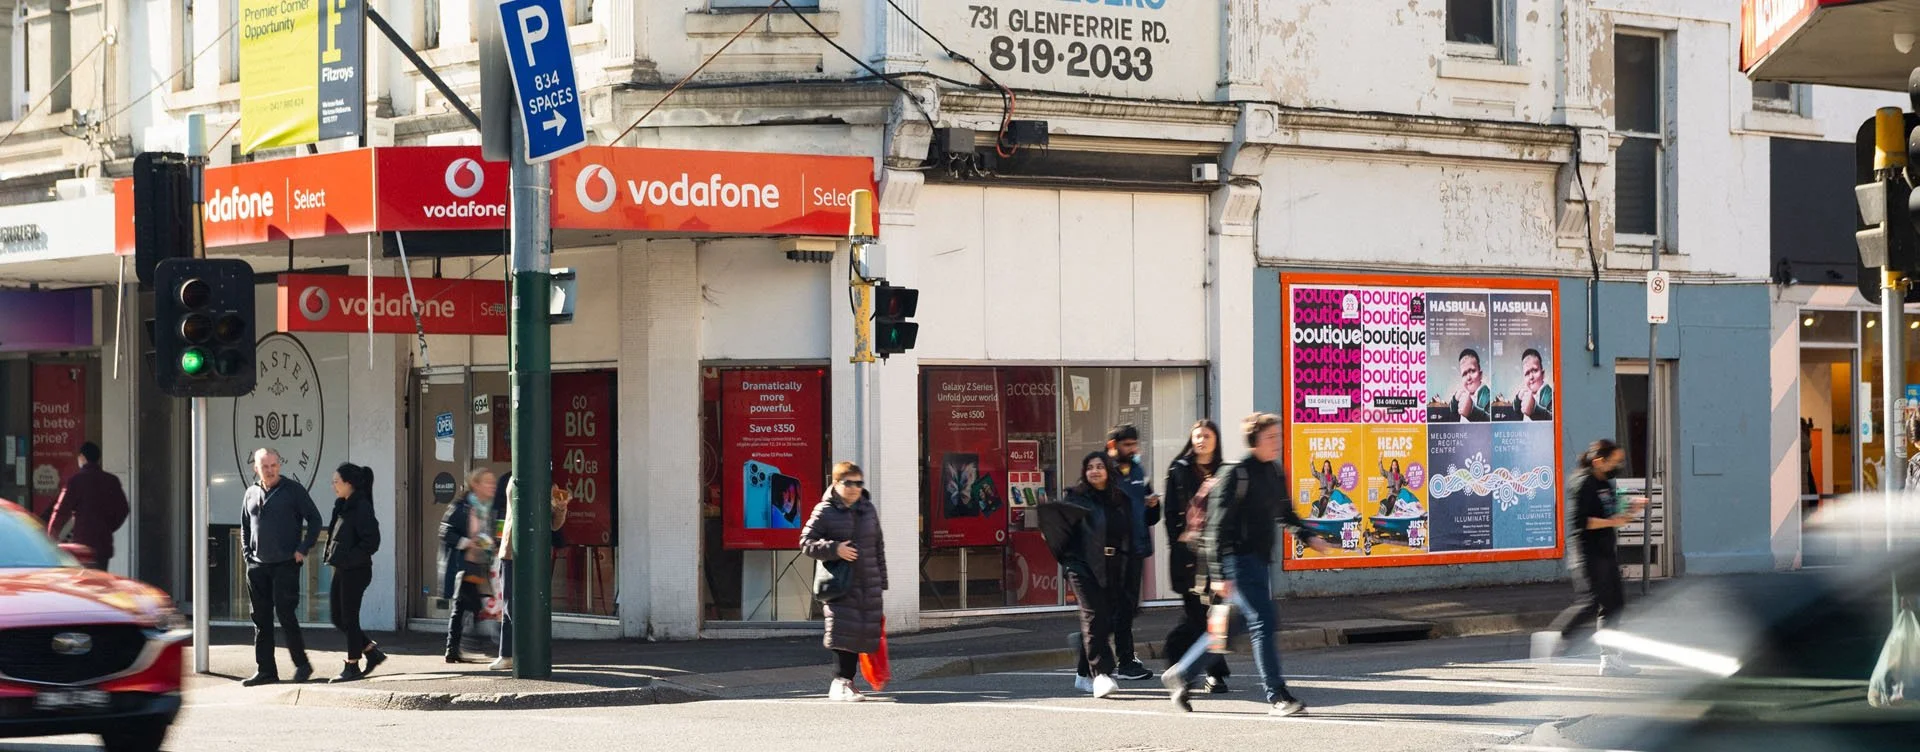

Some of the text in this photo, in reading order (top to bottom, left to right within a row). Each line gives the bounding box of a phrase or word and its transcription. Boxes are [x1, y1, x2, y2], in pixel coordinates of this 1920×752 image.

[245, 5, 278, 21] Premier
[245, 18, 295, 40] Opportunity
[968, 5, 1170, 44] 731 GLENFERRIE RD.
[517, 5, 549, 67] P
[322, 66, 354, 82] Fitzroys
[534, 70, 560, 91] 834
[529, 87, 573, 115] SPACES
[627, 172, 853, 209] vodafone Selec
[205, 185, 326, 223] dafone Select
[423, 200, 506, 218] vodafone
[338, 292, 455, 318] vodafone
[1429, 300, 1486, 312] HASBULLA
[1493, 301, 1548, 313] HASBULLA
[1293, 322, 1361, 350] boutique
[1363, 324, 1425, 350] boutique
[1294, 344, 1361, 370] boutique
[1363, 344, 1425, 370] boutique
[1294, 364, 1361, 390] boutique
[1363, 364, 1425, 390] boutique
[742, 381, 802, 392] Dramatically
[942, 382, 966, 393] Galaxy
[972, 382, 993, 390] Series
[474, 399, 488, 412] 694
[572, 395, 587, 410] GO
[937, 393, 998, 403] Unfold your world
[33, 402, 69, 414] Found
[750, 403, 794, 414] powerful.
[952, 411, 985, 419] Save $500
[33, 416, 80, 429] a bette
[254, 411, 303, 440] ROLL
[437, 419, 453, 433] OPEN
[564, 411, 596, 437] BIG
[749, 424, 795, 433] Save $350
[33, 431, 69, 446] price?
[1309, 437, 1345, 451] HEAPS
[1377, 437, 1413, 450] HEAPS
[563, 449, 598, 475] 40GB
[566, 477, 596, 503] $40
[1454, 515, 1490, 523] ILLUMINATE
[1517, 512, 1552, 520] ILLUMINATE
[1342, 522, 1358, 530] JUST
[1408, 520, 1424, 529] JUST
[1342, 539, 1358, 548] BEST
[1408, 538, 1424, 546] BEST
